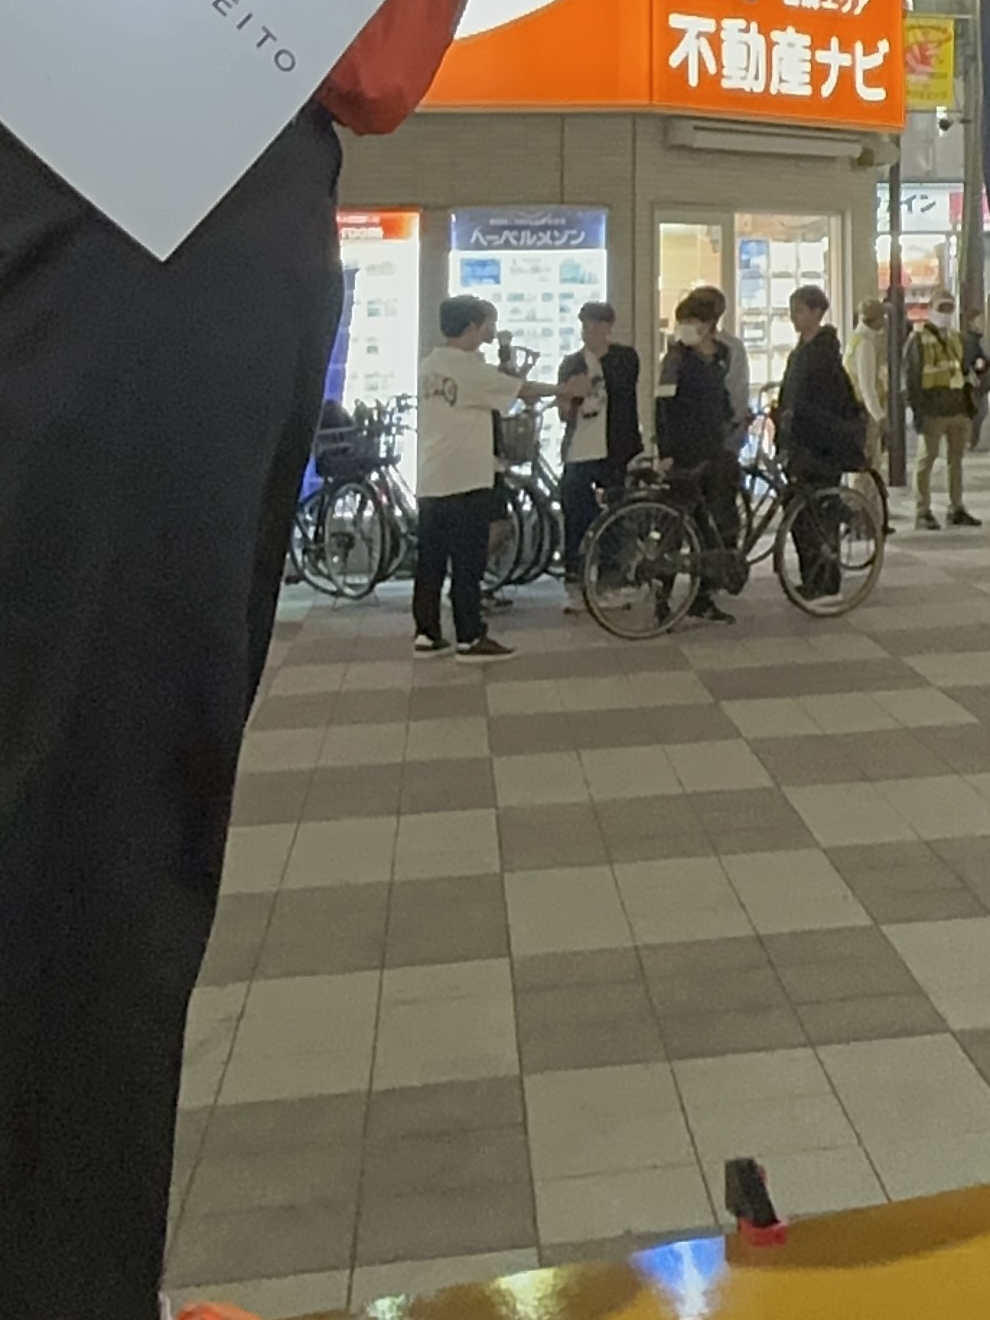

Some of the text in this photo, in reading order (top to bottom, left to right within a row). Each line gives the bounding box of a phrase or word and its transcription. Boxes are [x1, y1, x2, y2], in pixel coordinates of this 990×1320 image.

[668, 12, 890, 101] 不動産ナビ
